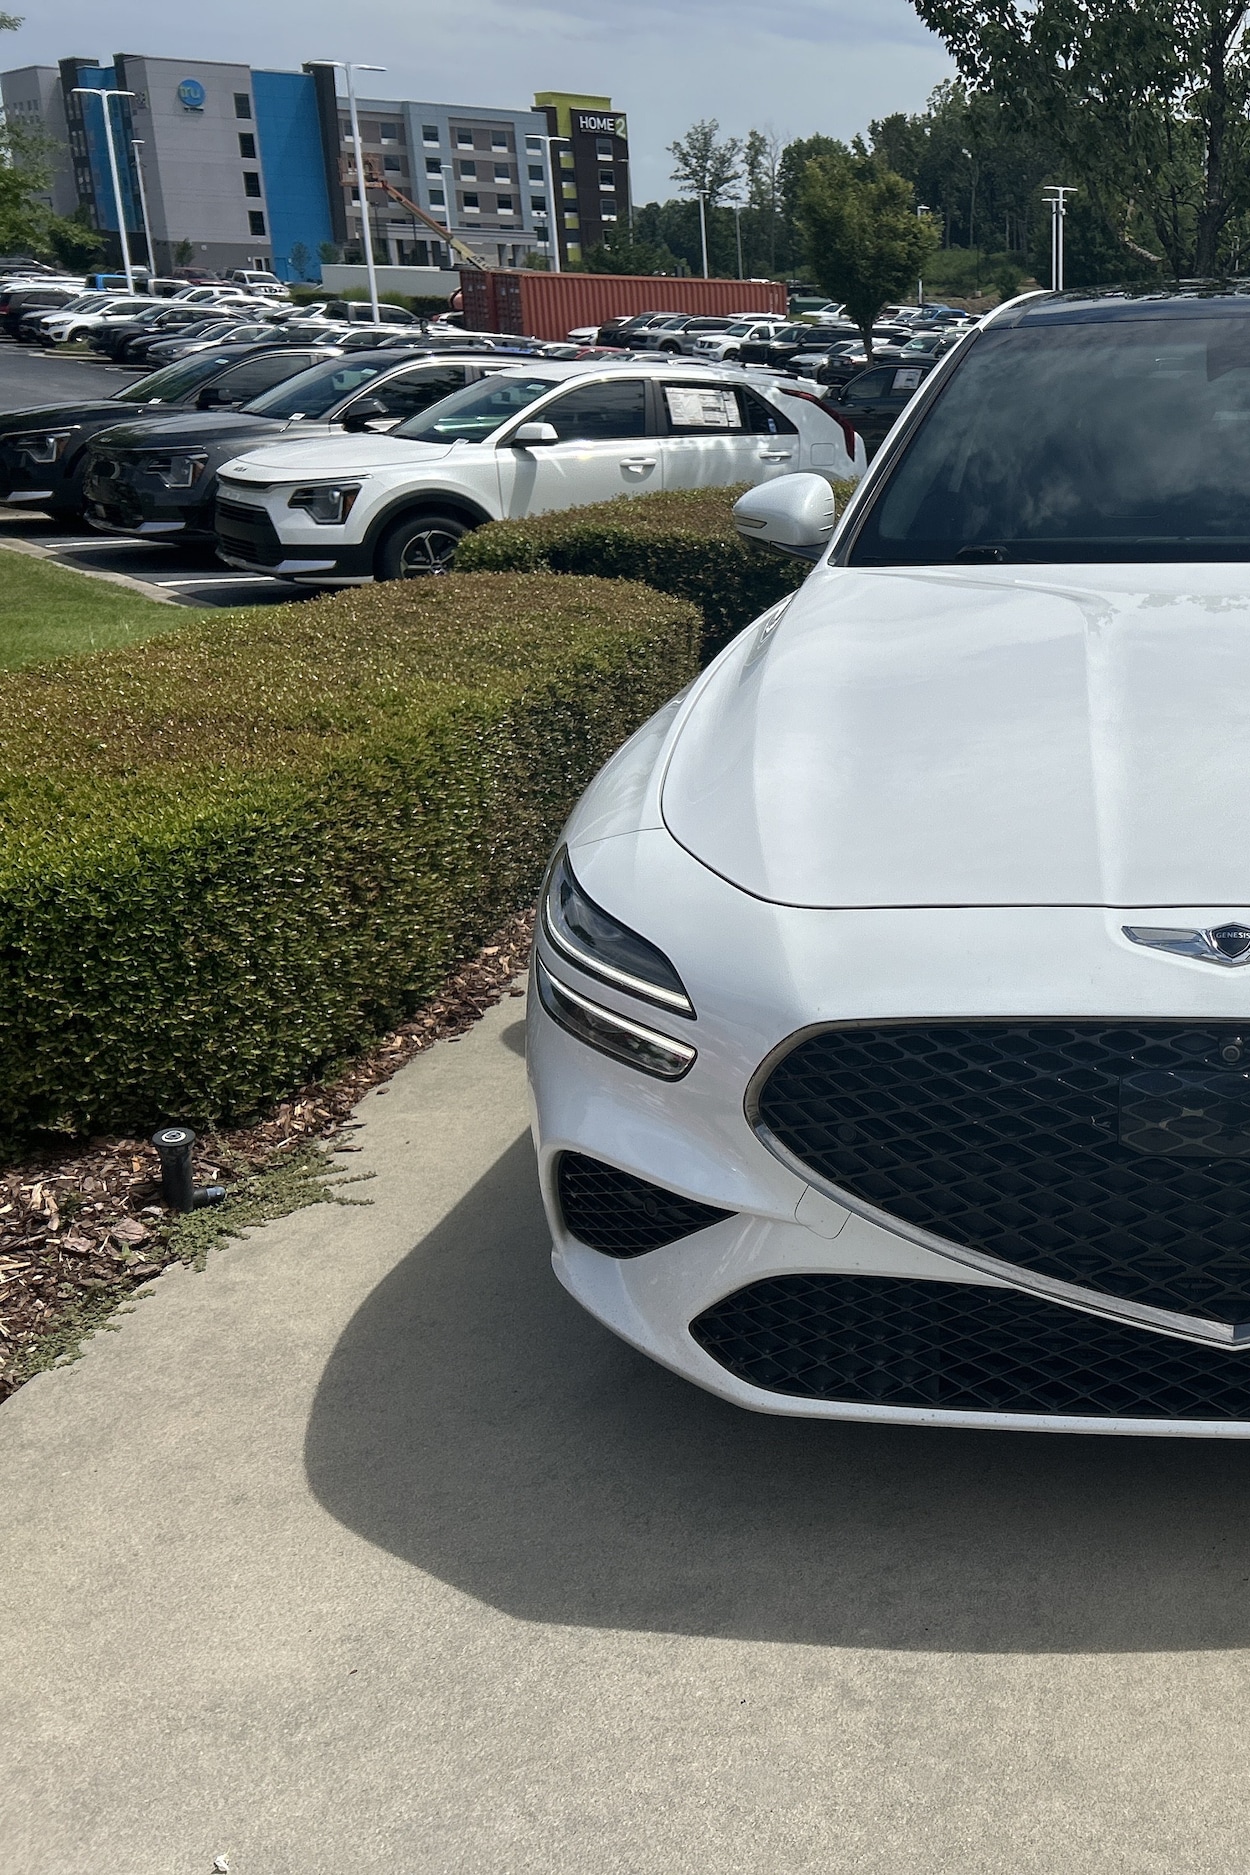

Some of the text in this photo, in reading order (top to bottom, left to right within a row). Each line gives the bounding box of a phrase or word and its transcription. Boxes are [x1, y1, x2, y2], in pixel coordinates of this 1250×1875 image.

[579, 115, 627, 139] HOME 2
[1215, 931, 1250, 939] GENESIS
